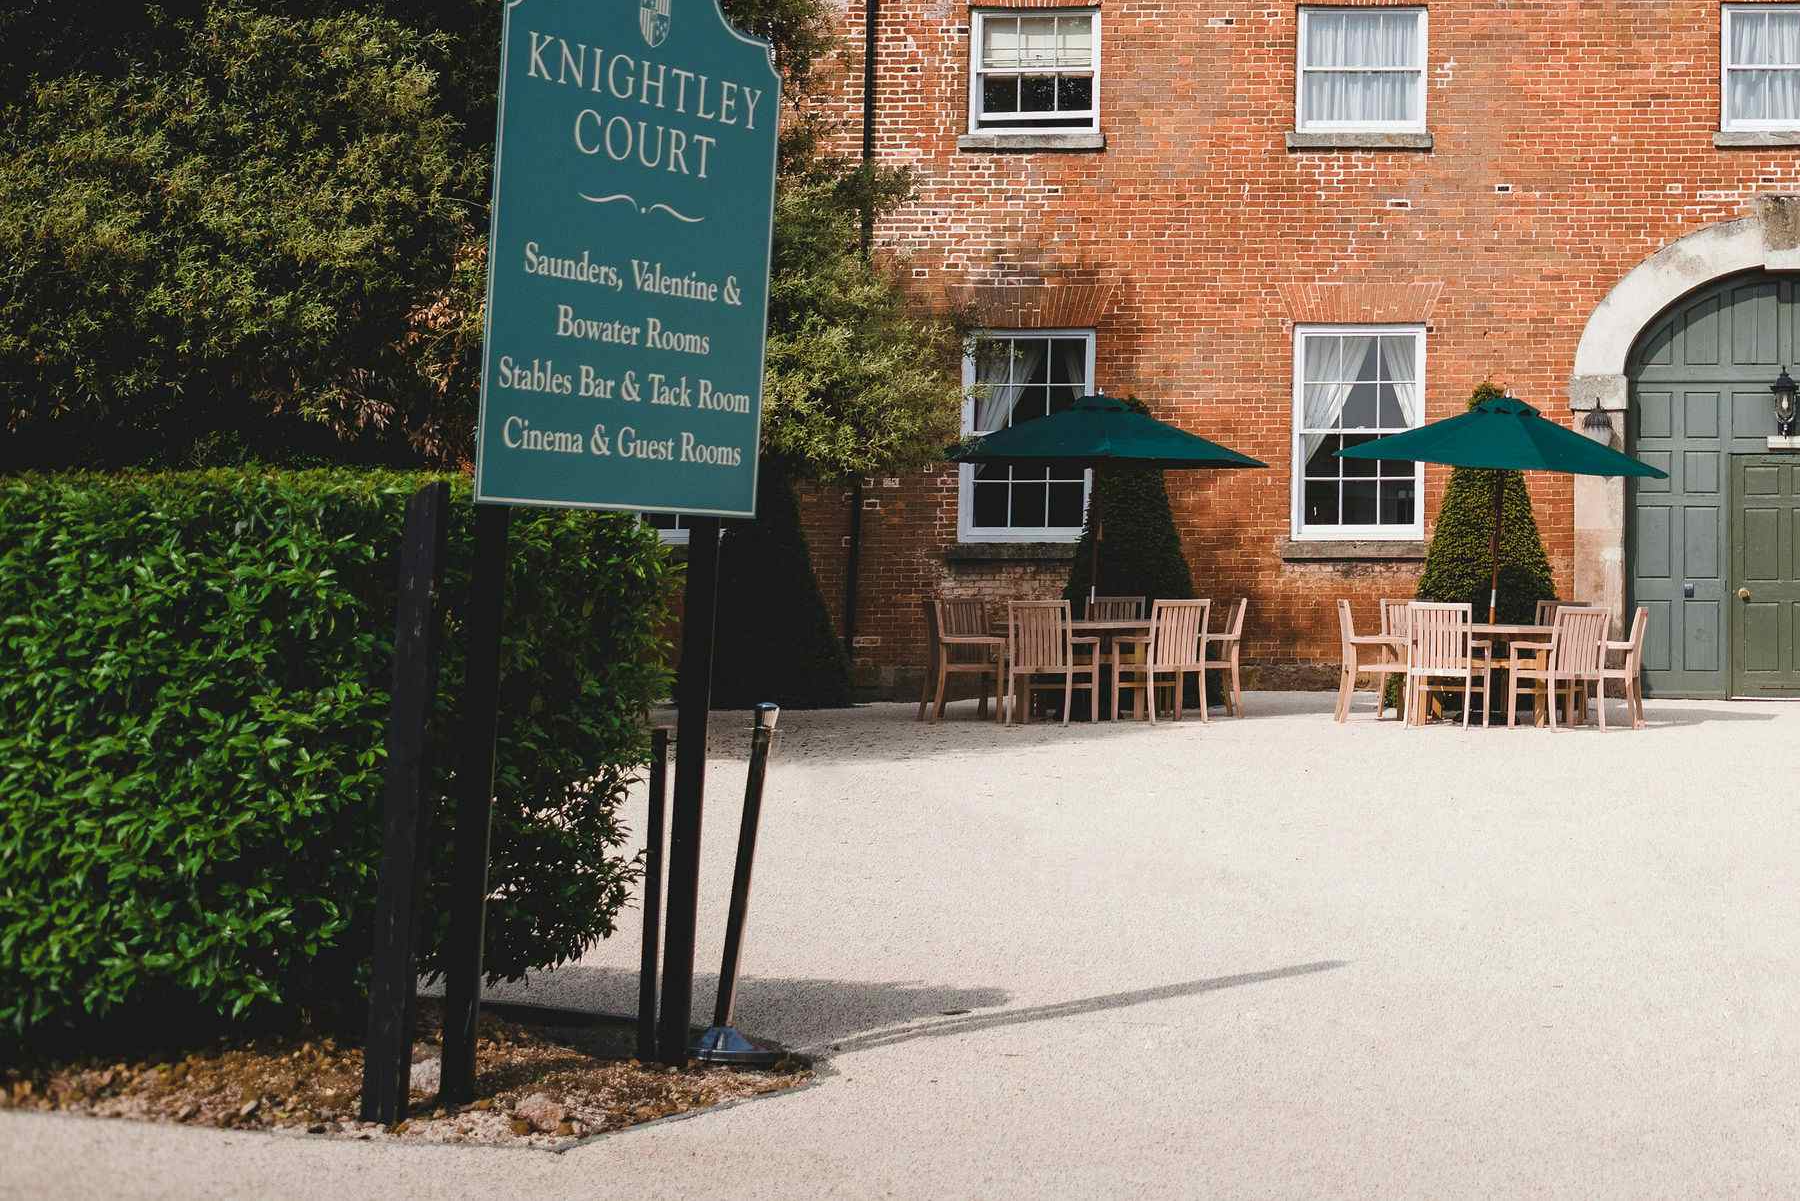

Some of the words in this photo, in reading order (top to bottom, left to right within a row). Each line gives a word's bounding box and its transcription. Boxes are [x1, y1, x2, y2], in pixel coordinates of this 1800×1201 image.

[527, 30, 762, 130] KNIGHTLEY
[574, 109, 716, 179] COURT
[524, 241, 624, 292] Saunders,
[631, 259, 718, 302] Valentine
[723, 275, 743, 306] &
[556, 304, 641, 346] Bowater
[645, 317, 710, 355] Rooms
[498, 355, 572, 395] Stables
[578, 365, 615, 399] Bar
[621, 370, 641, 403] &
[648, 373, 692, 408] Tack
[698, 378, 750, 414] Room
[502, 415, 583, 454] Cinema
[590, 423, 611, 456] &
[617, 426, 675, 460] Guest
[680, 431, 741, 467] Rooms
